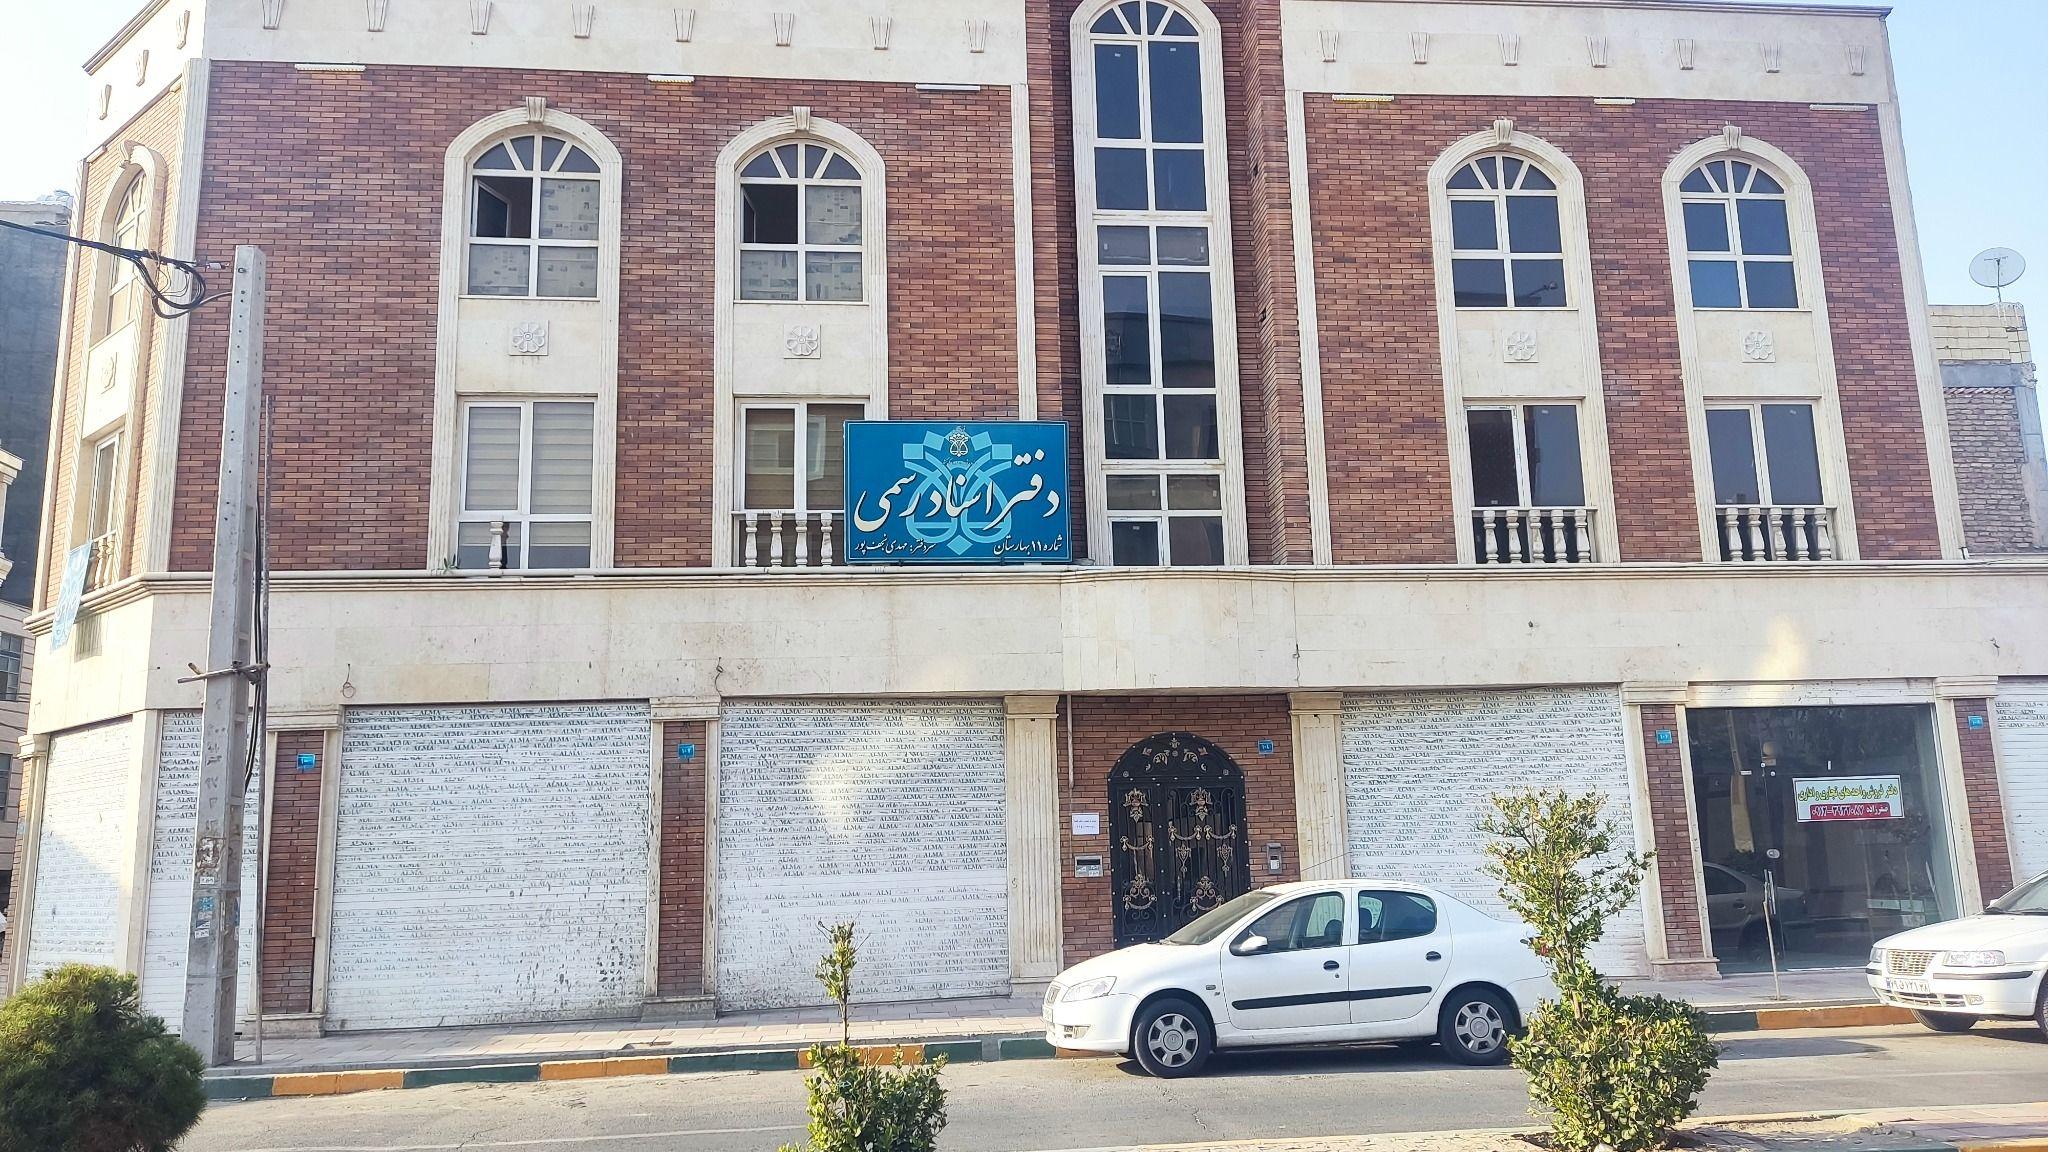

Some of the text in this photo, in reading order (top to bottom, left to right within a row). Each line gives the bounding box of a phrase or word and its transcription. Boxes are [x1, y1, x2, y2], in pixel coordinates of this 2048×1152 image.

[853, 449, 1060, 532] دفتر اسناد رسمی
[885, 539, 908, 554] مهدی
[993, 534, 1063, 555] شماره ۱۱ بهارستان
[1798, 786, 1816, 801] اداری
[1820, 786, 1838, 800] تجاری
[1867, 784, 1884, 800] فروش
[1885, 784, 1898, 798] دفتر
